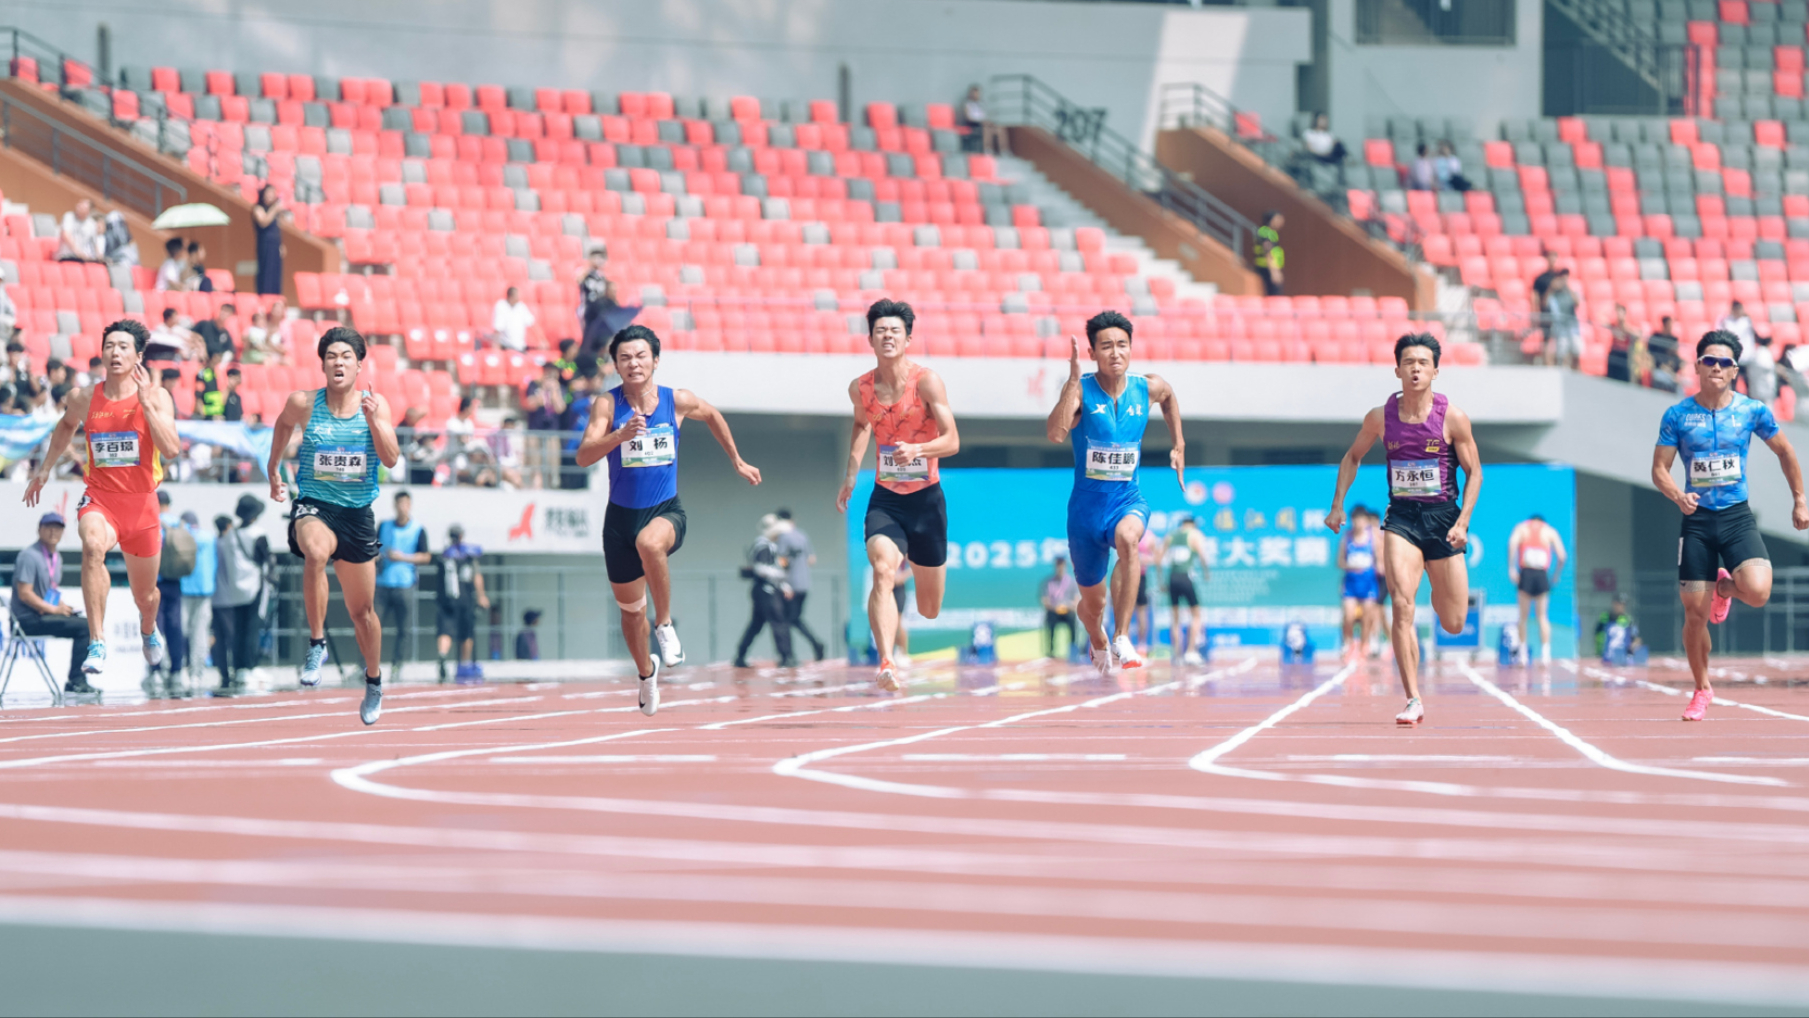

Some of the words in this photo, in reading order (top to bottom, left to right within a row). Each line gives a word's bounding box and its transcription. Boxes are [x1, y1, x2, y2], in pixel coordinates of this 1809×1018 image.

[1054, 109, 1106, 143] 207
[318, 454, 362, 467] 张贵森
[1092, 451, 1135, 464] 陈佳鹏
[1693, 459, 1735, 472] 黄仁秋
[1395, 469, 1434, 482] 方永恒
